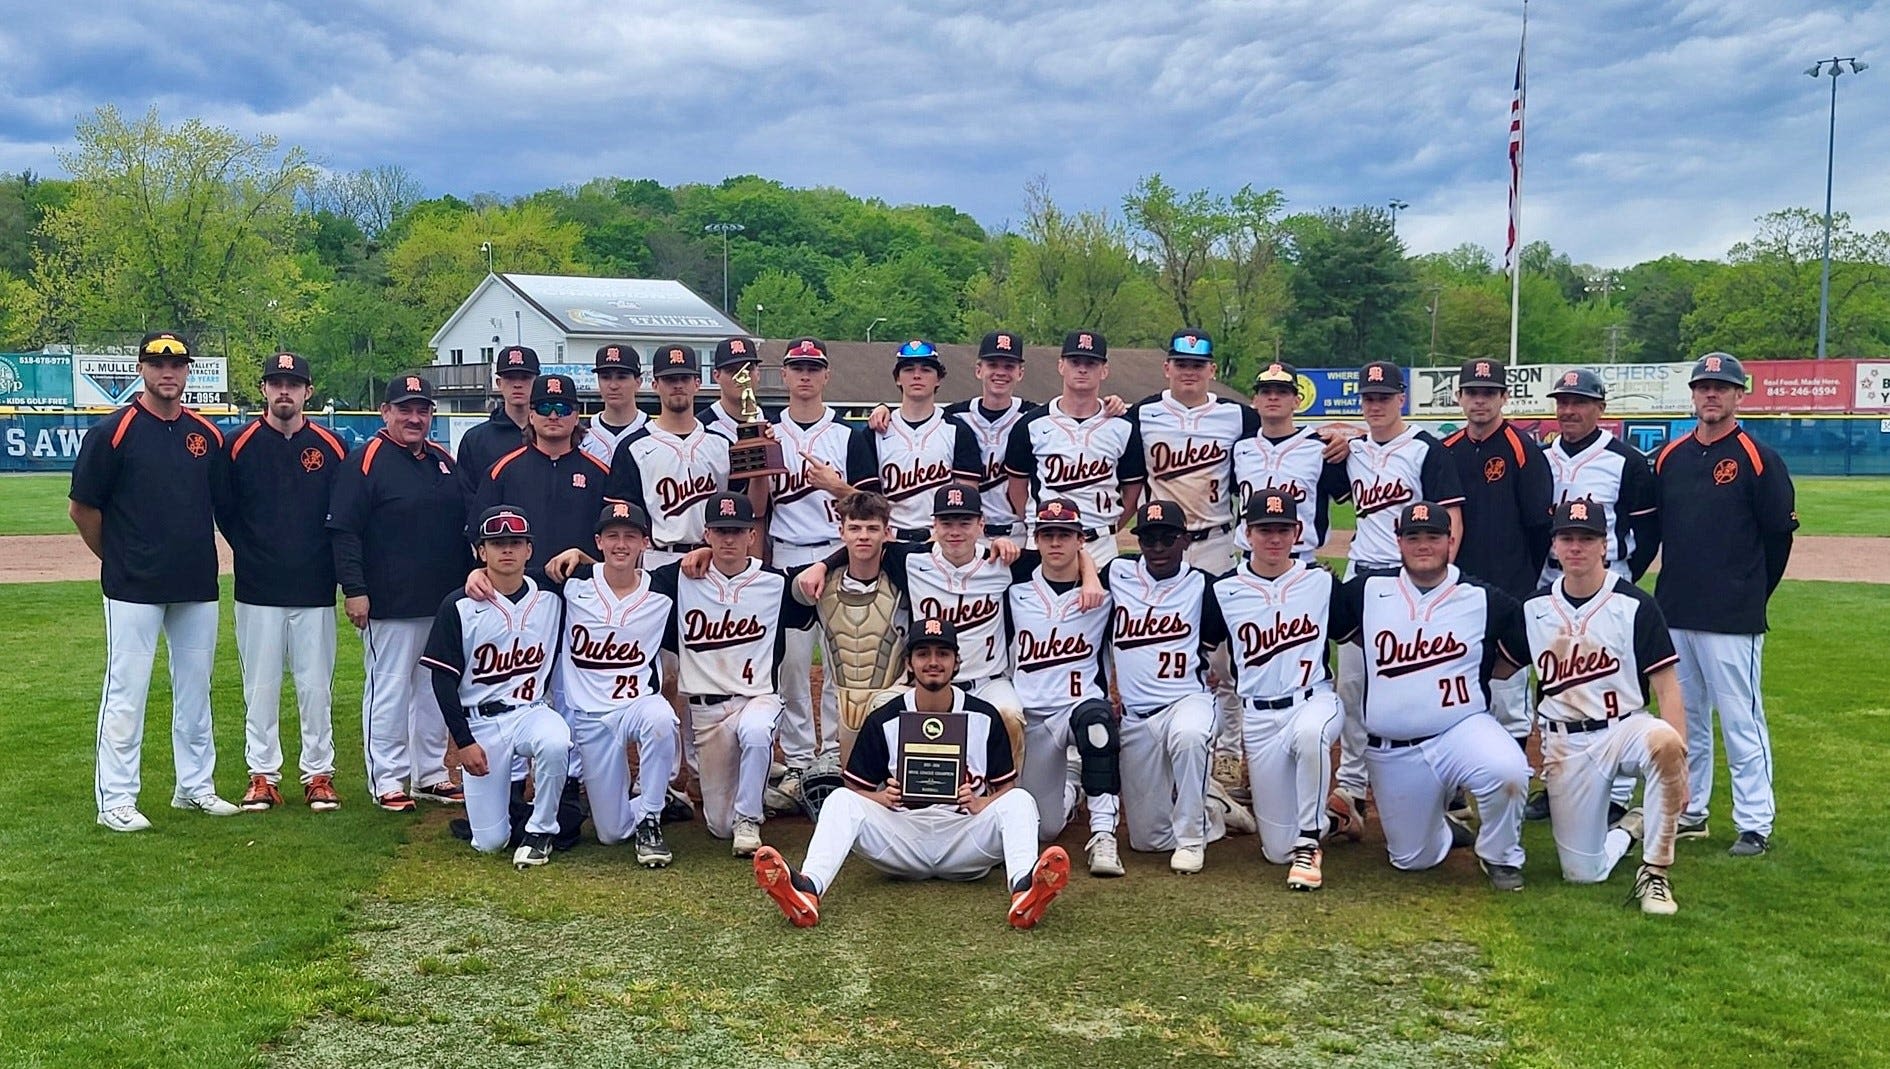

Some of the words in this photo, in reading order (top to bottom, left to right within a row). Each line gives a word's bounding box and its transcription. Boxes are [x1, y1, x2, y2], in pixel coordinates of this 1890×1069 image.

[19, 357, 70, 365] 518-678-9779
[85, 363, 94, 372] J.
[1327, 372, 1360, 380] WHERE
[1323, 399, 1332, 407] IS
[1334, 399, 1357, 407] WHAT
[1044, 452, 1112, 484] Dukes
[1150, 437, 1224, 473] Dukes
[882, 457, 952, 495] Dukes
[1209, 479, 1220, 503] 3
[1096, 490, 1112, 514] 14
[920, 593, 998, 624] Dukes
[1114, 605, 1188, 638] Dukes
[684, 608, 764, 642] Dukes
[1238, 611, 1315, 659] Dukes
[472, 637, 545, 676] Dukes
[571, 624, 643, 662] Dukes
[985, 635, 994, 662] 2
[1018, 627, 1091, 663] Dukes
[1375, 628, 1463, 667] Dukes
[742, 658, 754, 685] 4
[1157, 652, 1187, 679] 29
[1300, 660, 1312, 687] 7
[1538, 643, 1616, 684] Dukes
[612, 675, 640, 699] 23
[1070, 671, 1082, 697] 6
[1439, 675, 1470, 707] 20
[1603, 690, 1619, 719] 9
